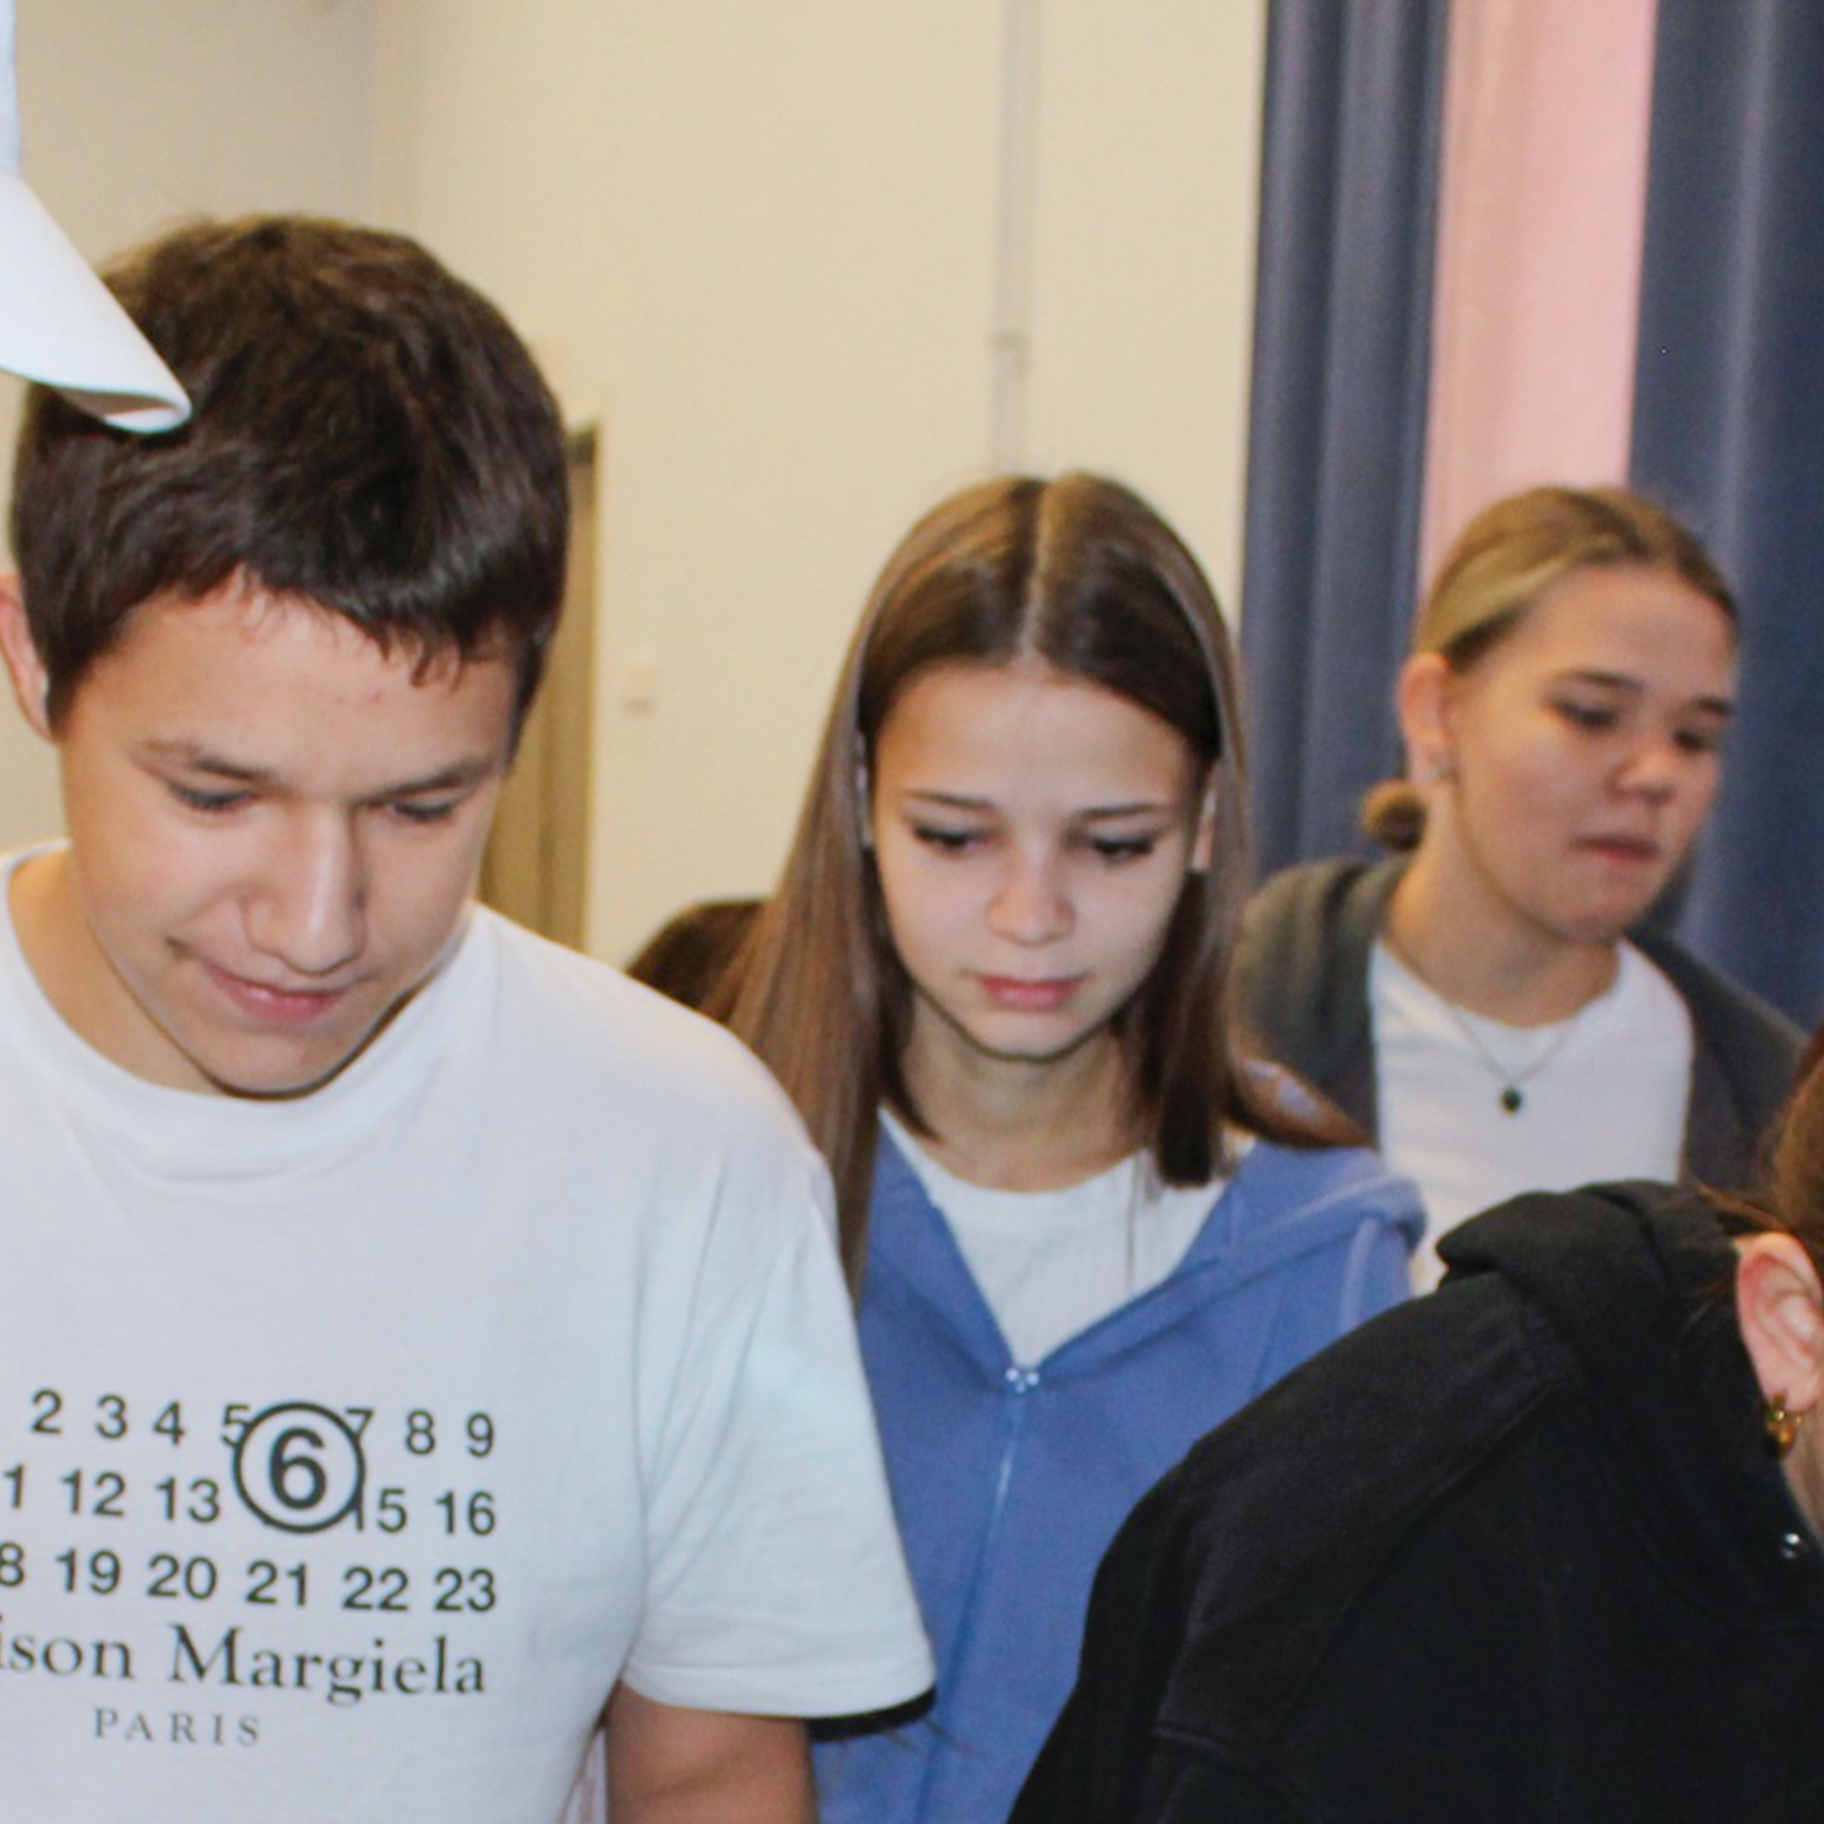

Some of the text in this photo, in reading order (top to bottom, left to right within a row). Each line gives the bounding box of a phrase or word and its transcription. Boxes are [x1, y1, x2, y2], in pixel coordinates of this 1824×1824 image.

[30, 1388, 63, 1434] 2
[95, 1394, 128, 1439] 3
[153, 1400, 186, 1446] 4
[221, 1404, 252, 1448] 5
[269, 1426, 326, 1511] 6
[345, 1407, 375, 1446] 7
[405, 1409, 435, 1455] 8
[467, 1412, 494, 1458] 9
[61, 1468, 125, 1517] 12
[156, 1476, 220, 1523] 13
[435, 1489, 496, 1536] 16
[56, 1547, 122, 1595] 19
[146, 1554, 218, 1600] 20
[245, 1559, 307, 1607] 21
[342, 1566, 409, 1611] 22
[434, 1567, 497, 1613] 23
[167, 1623, 487, 1706] Margiela
[93, 1707, 260, 1746] PARIS
